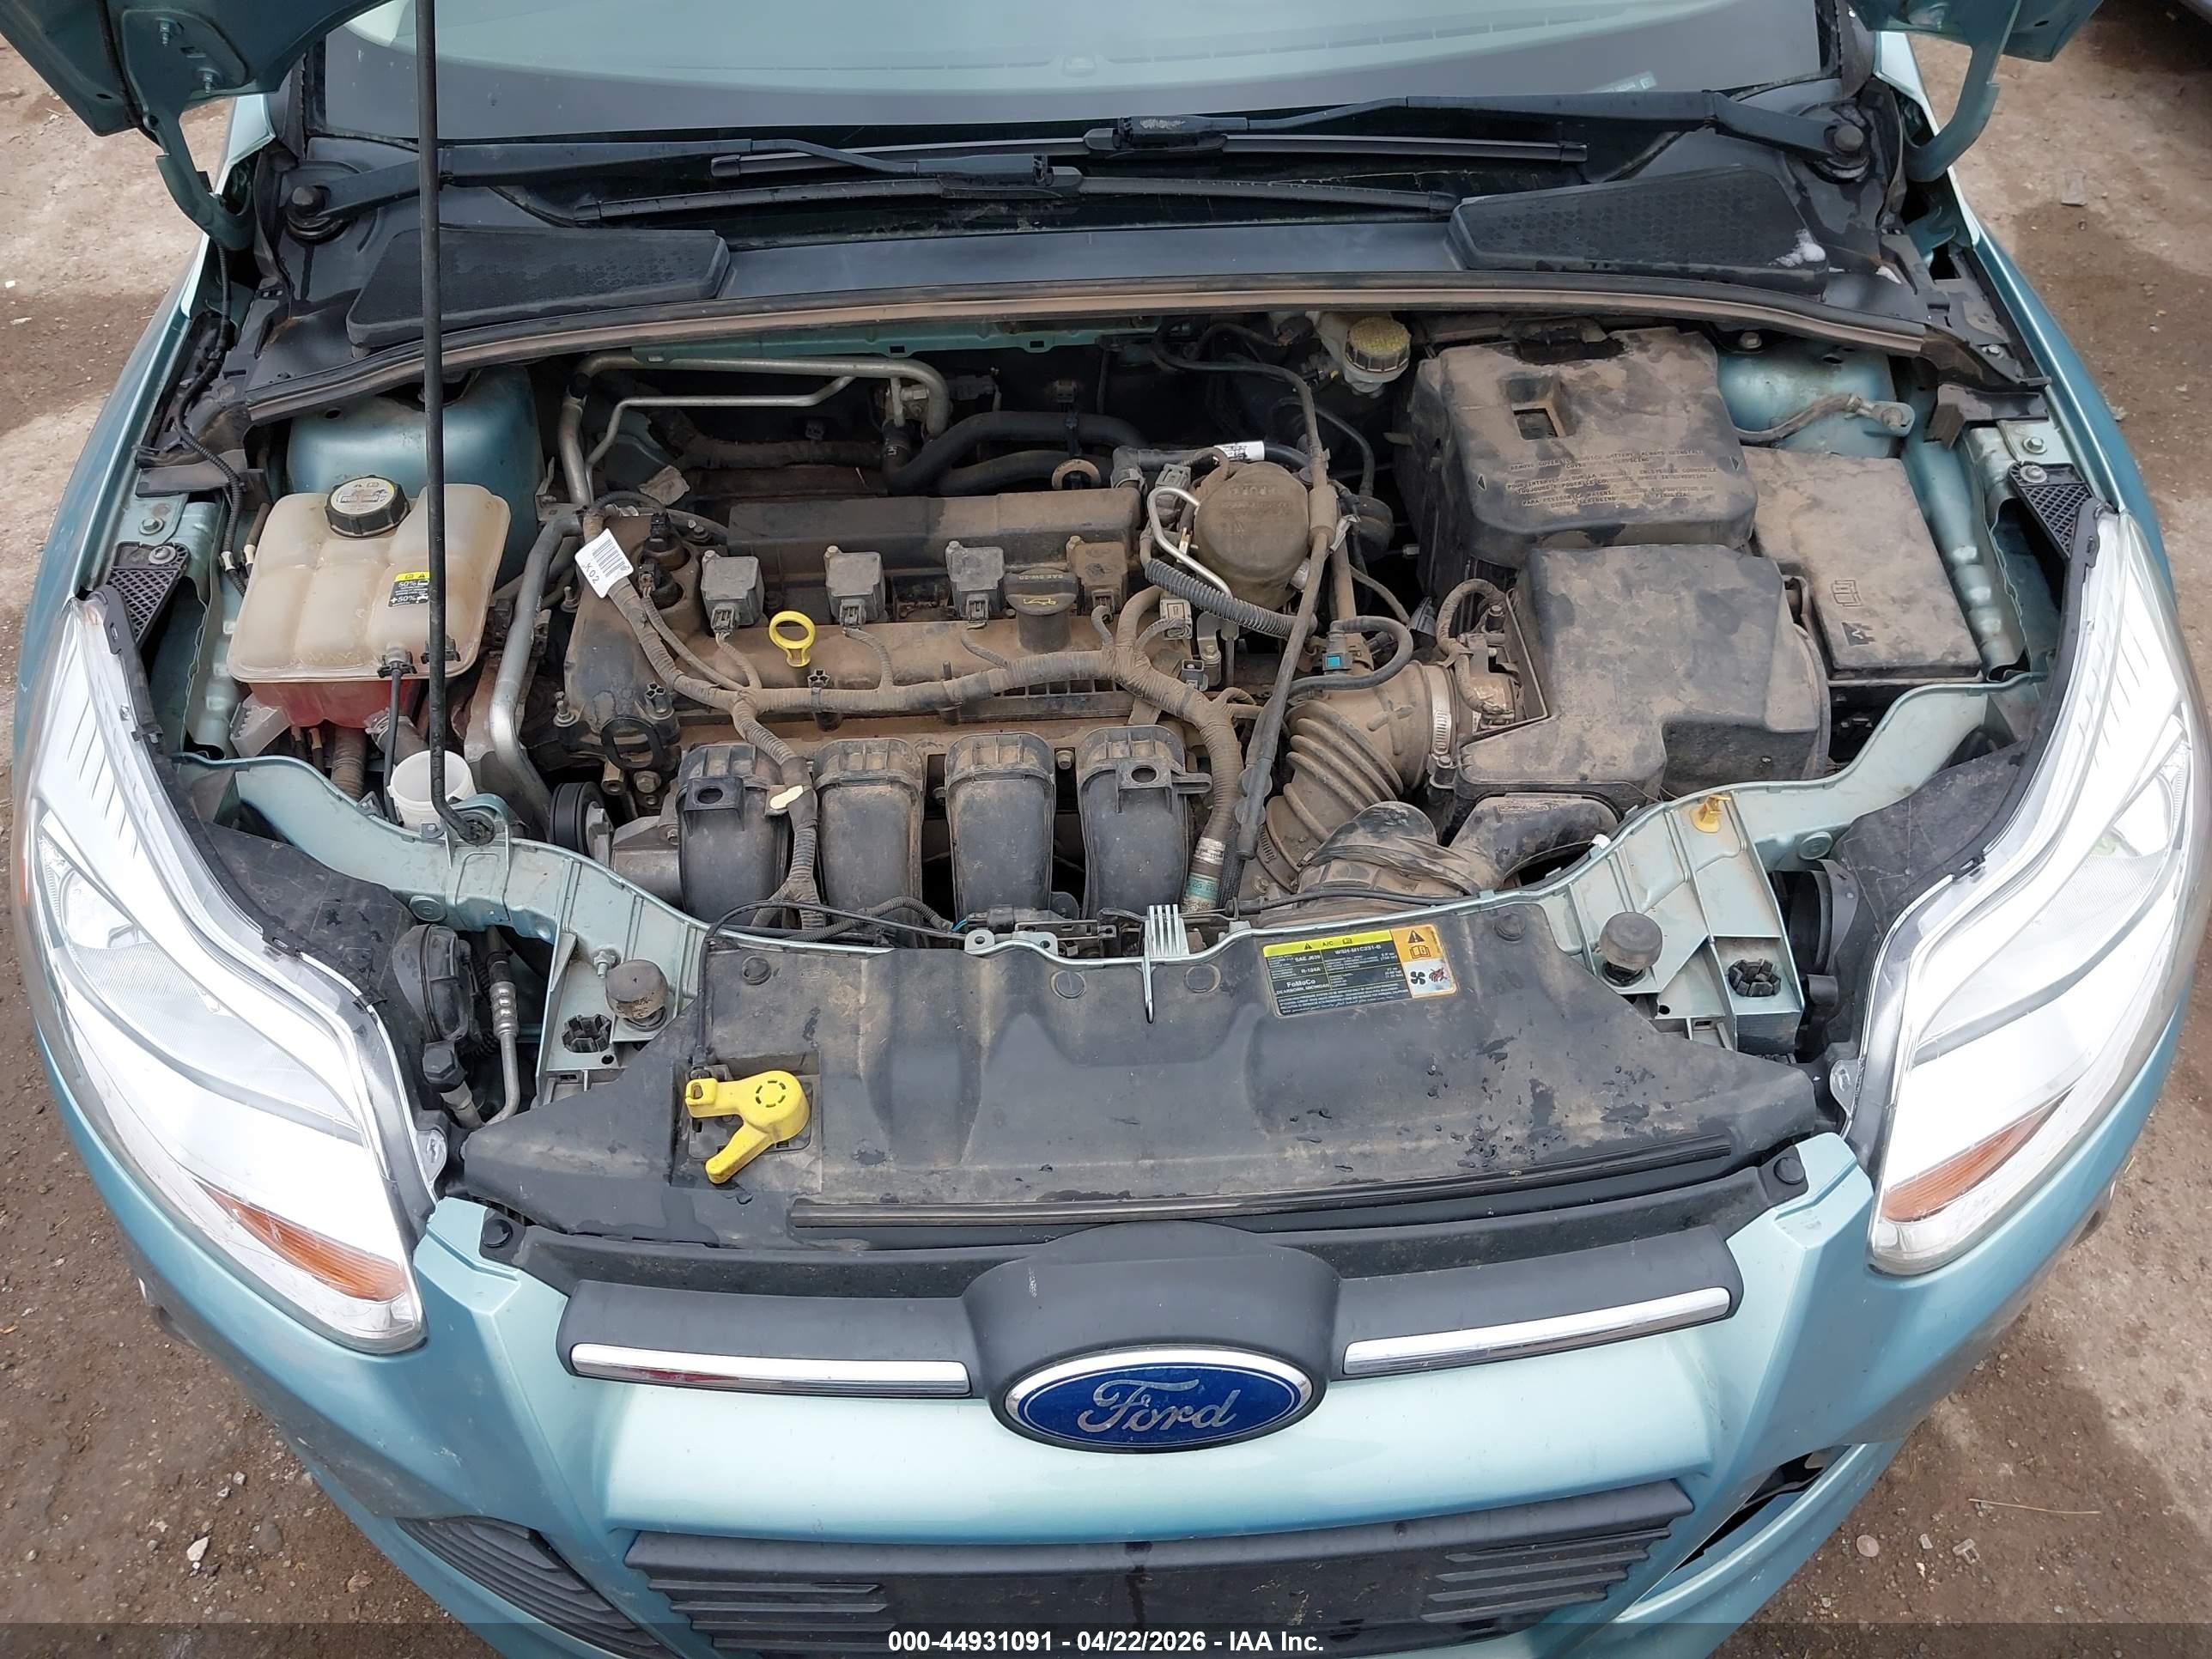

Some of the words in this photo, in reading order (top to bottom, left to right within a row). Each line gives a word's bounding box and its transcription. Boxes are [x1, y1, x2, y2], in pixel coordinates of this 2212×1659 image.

[584, 562, 599, 584] K02
[1286, 979, 1316, 988] FoMoCo
[1077, 1378, 1241, 1433] Ford
